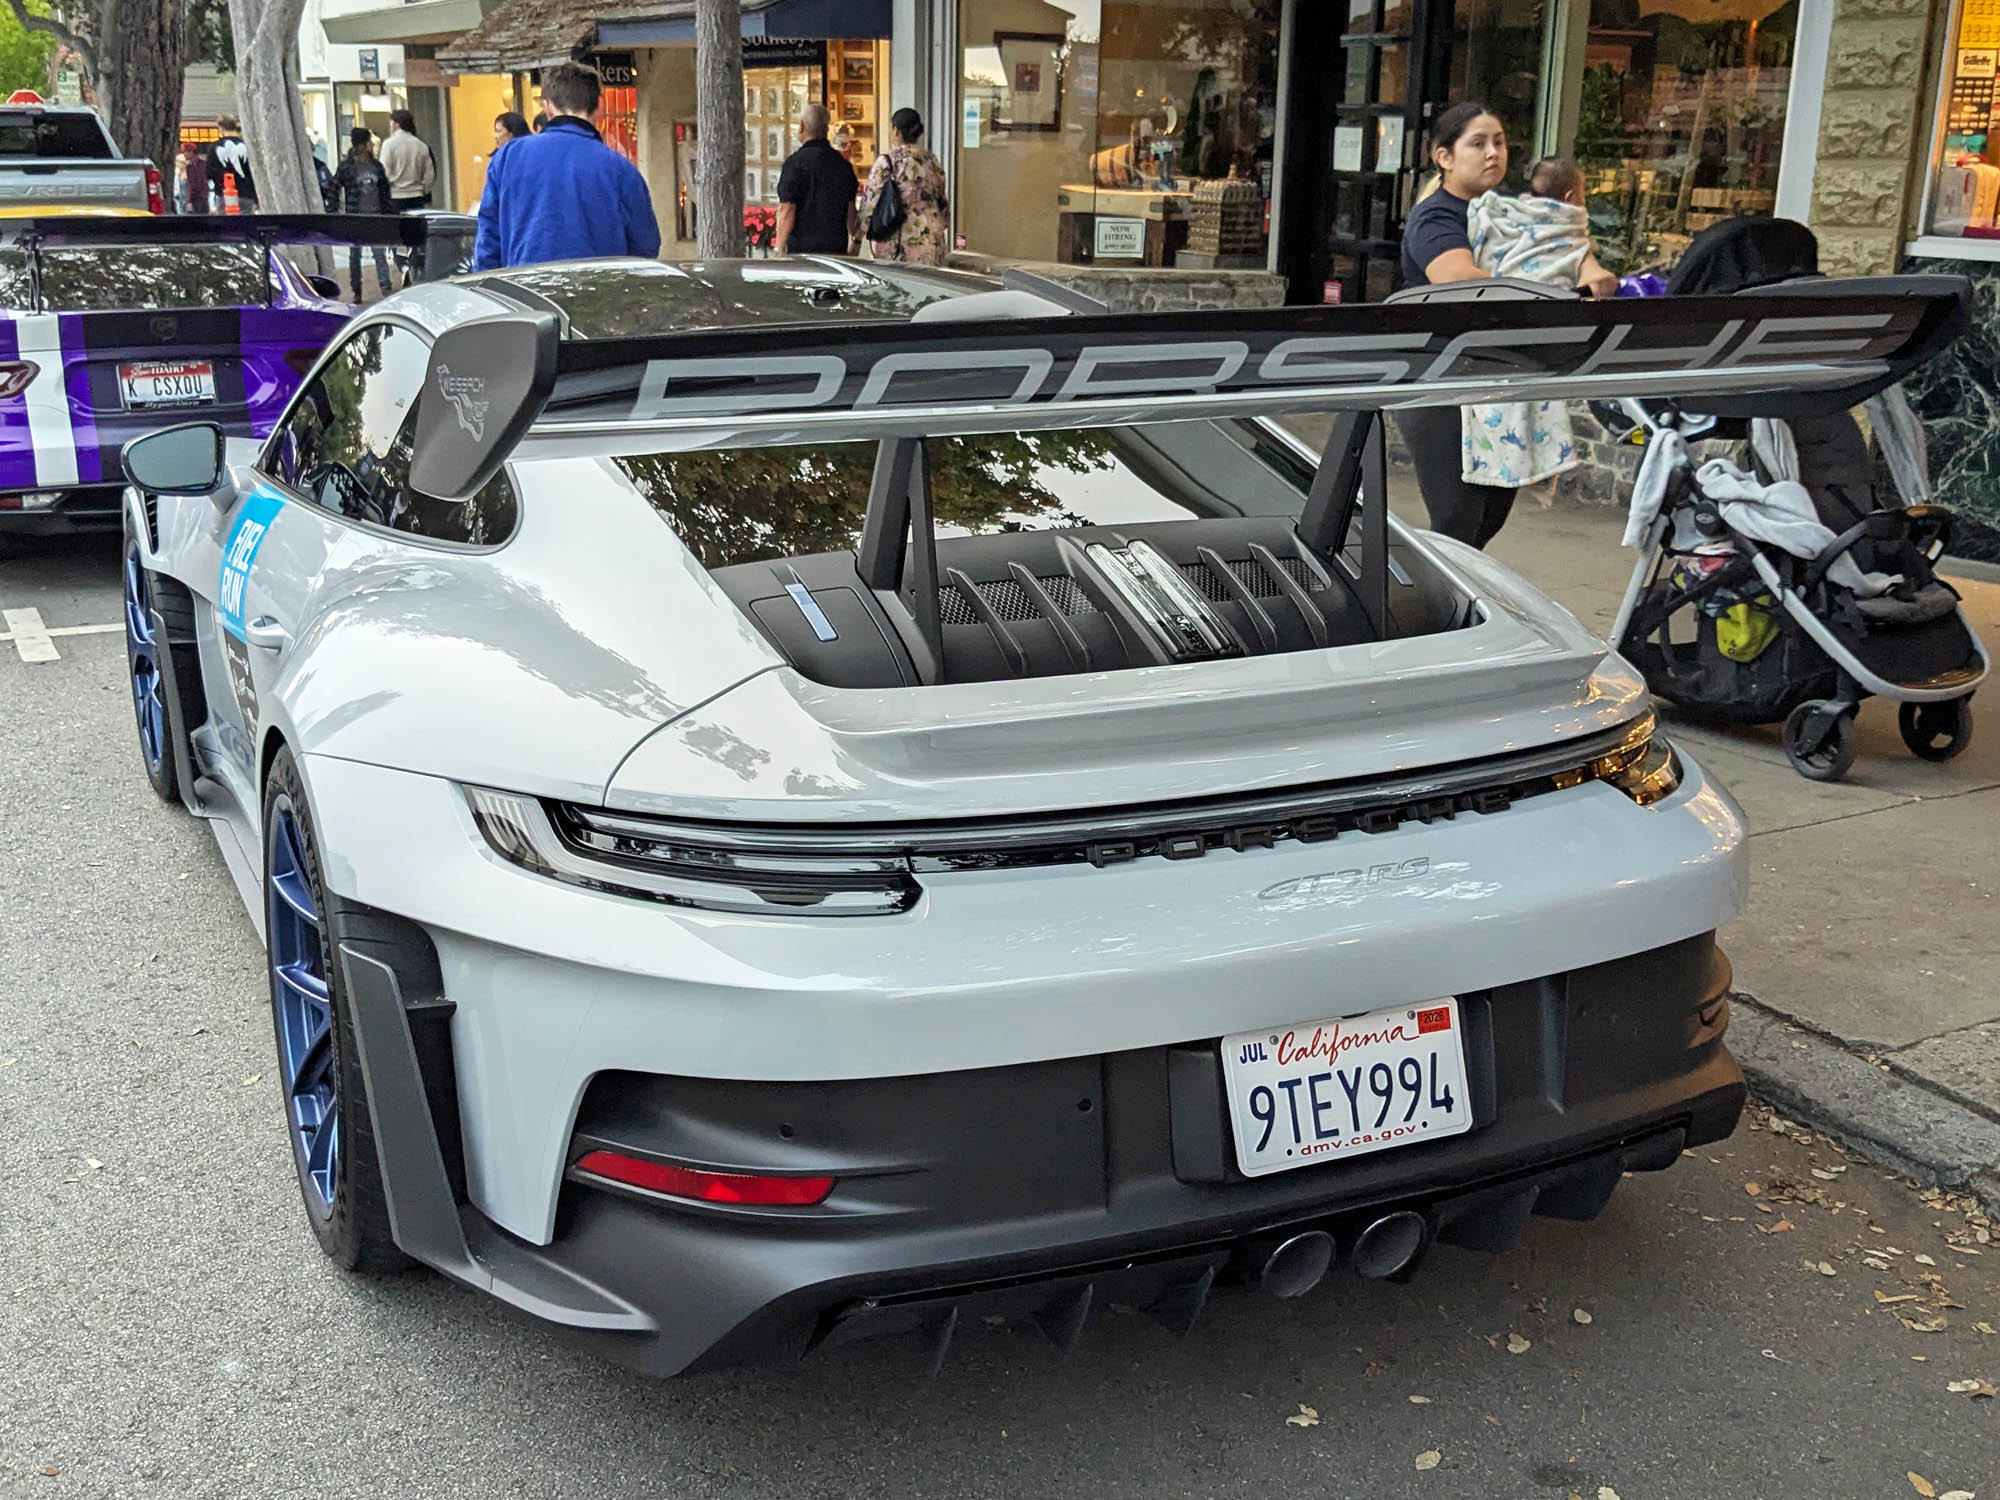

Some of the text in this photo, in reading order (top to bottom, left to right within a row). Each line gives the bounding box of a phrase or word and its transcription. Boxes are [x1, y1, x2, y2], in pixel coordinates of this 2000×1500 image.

[1104, 233, 1136, 241] HIRING
[127, 378, 138, 398] K
[629, 313, 1897, 421] PORSCHE
[227, 518, 266, 573] FUEL
[221, 566, 246, 619] RUN
[1086, 792, 1511, 868] PORSCHE
[1365, 855, 1430, 885] RS
[1239, 1023, 1420, 1067] JUL California
[1249, 1051, 1455, 1153] 9TEY994
[1300, 1125, 1417, 1157] dmv.ca.gov
